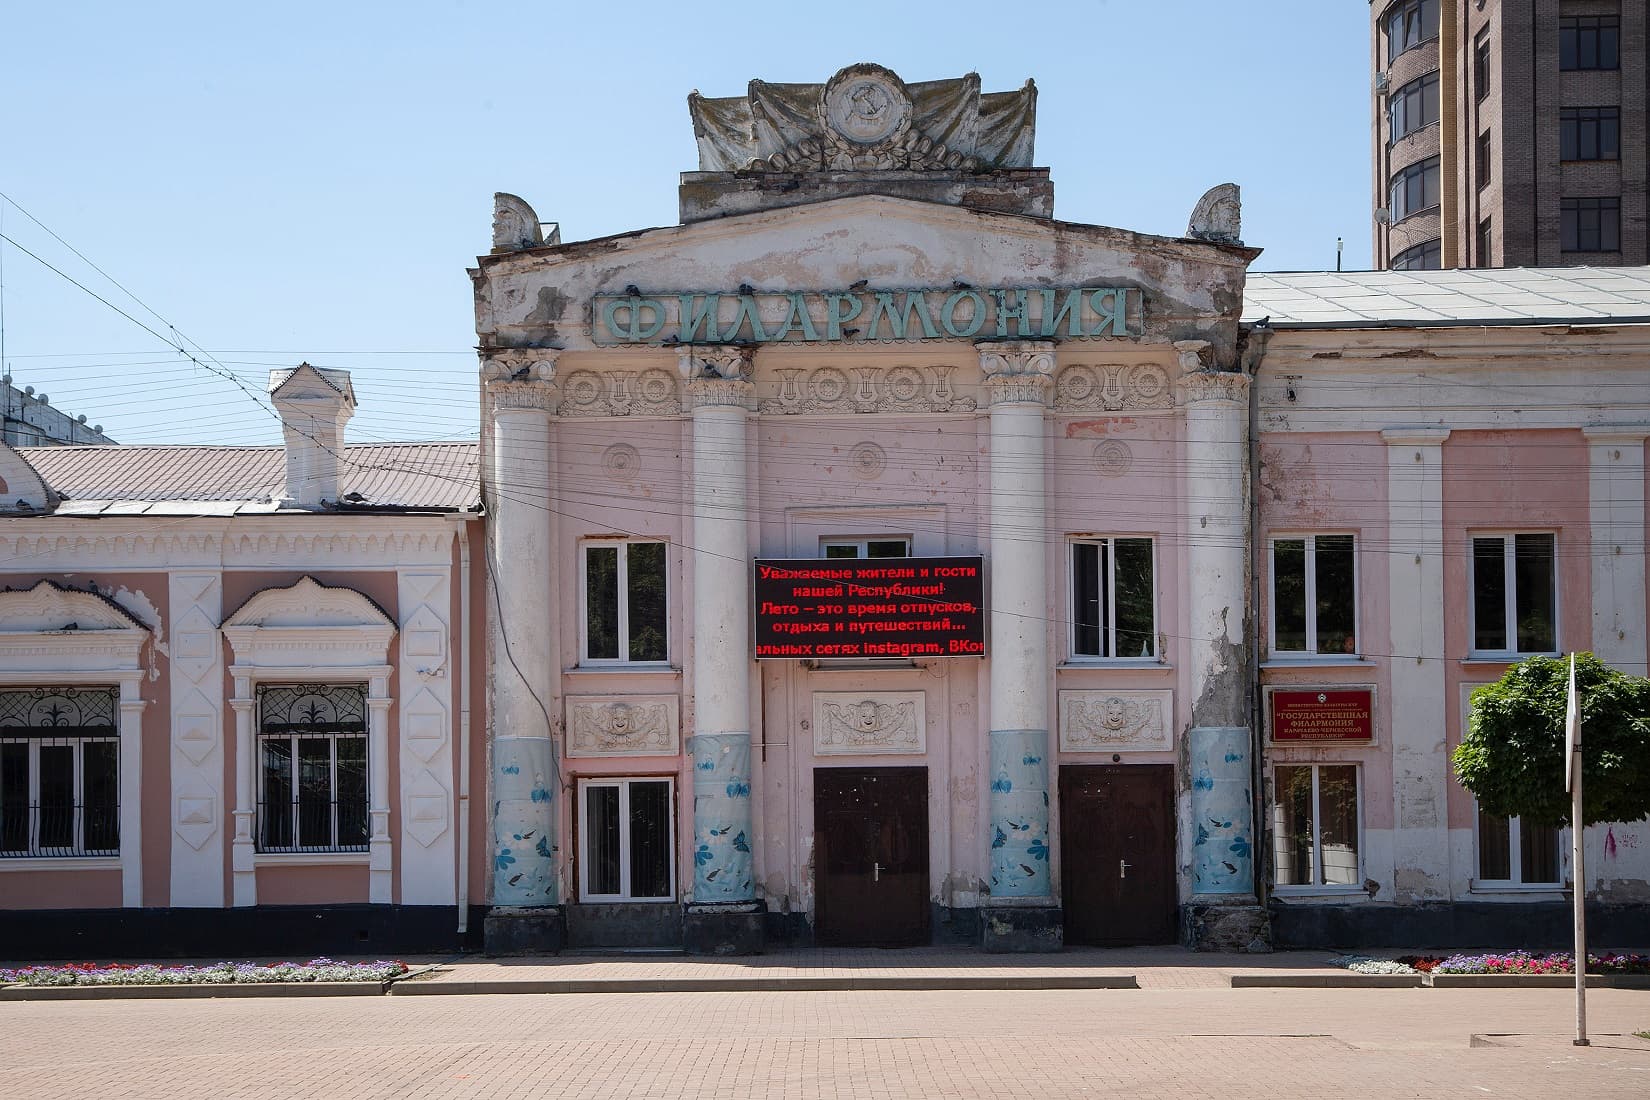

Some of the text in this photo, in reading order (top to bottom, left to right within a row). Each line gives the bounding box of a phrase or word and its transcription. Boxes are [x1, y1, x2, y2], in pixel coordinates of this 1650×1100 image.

[603, 289, 1127, 342] ФИЛАРМОНИЯ
[760, 566, 976, 579] Уважаемые жители и гости
[793, 582, 944, 599] нашей Республики!
[761, 601, 799, 615] Лето
[817, 605, 843, 615] это
[848, 603, 896, 617] время
[900, 602, 976, 616] отпусков,
[772, 622, 829, 634] отдыха
[835, 622, 844, 632] и
[816, 643, 859, 654] сетях
[1290, 719, 1354, 727] ФИЛАРМОНИЯ
